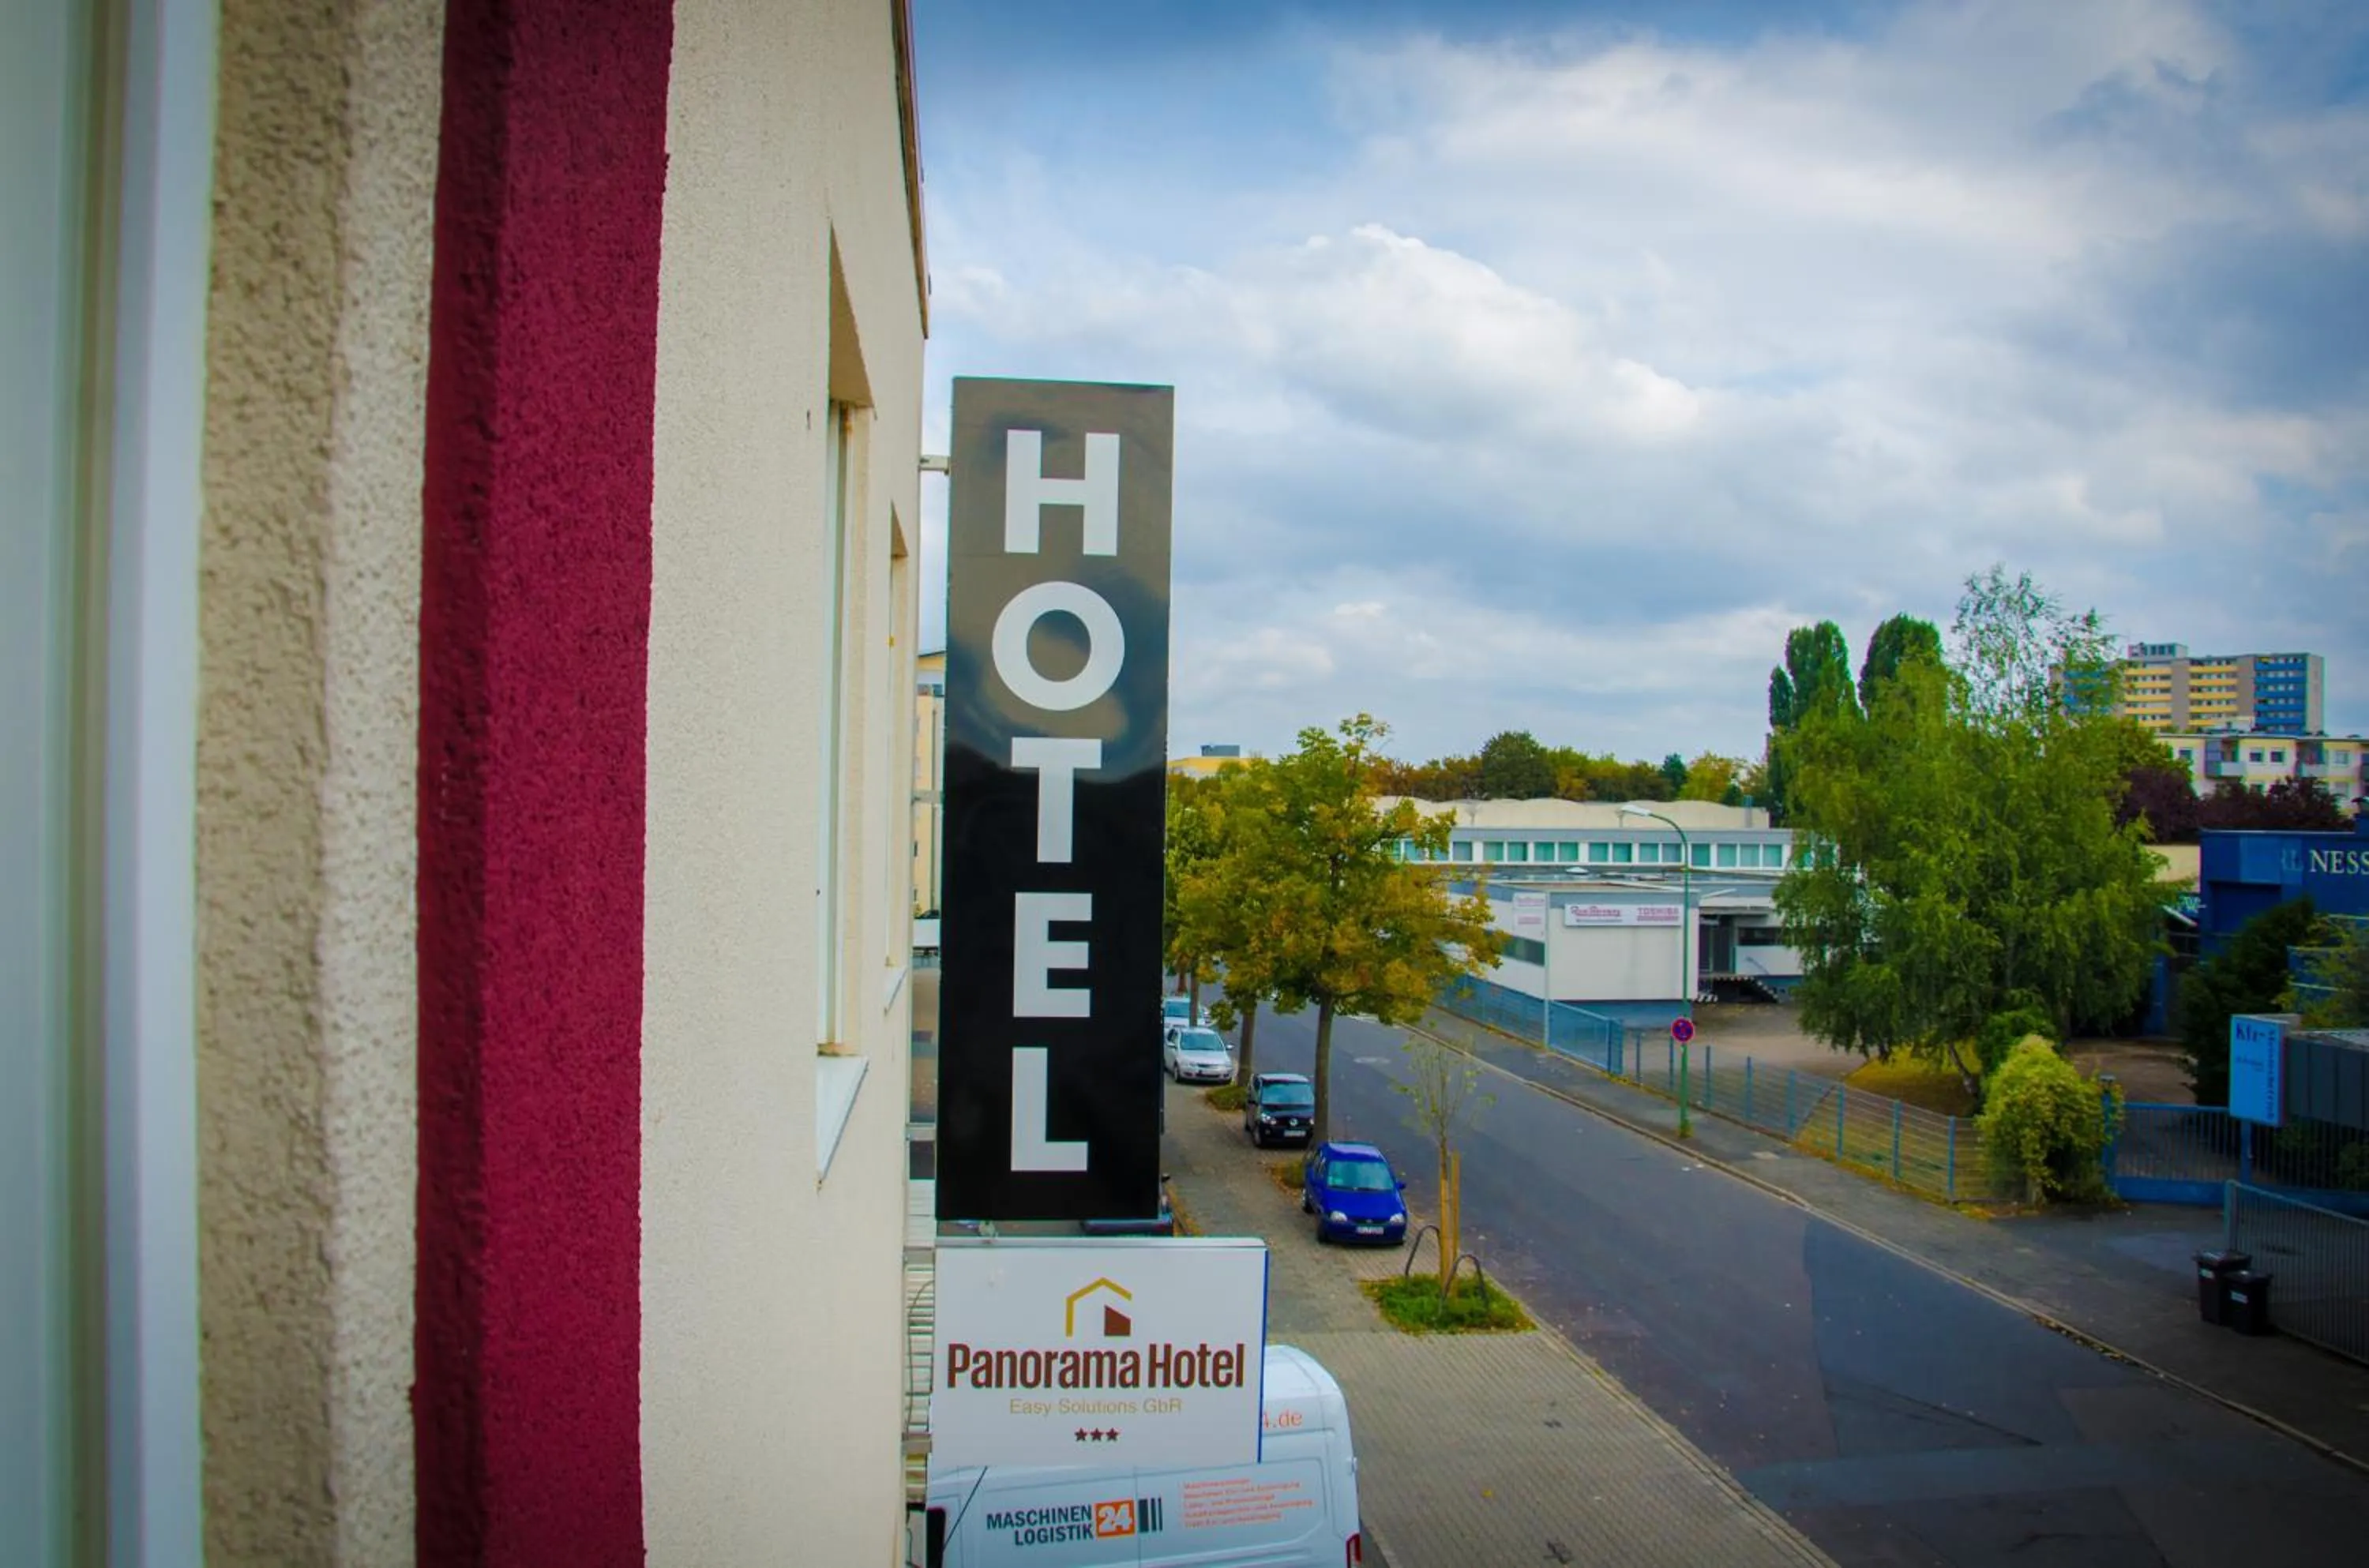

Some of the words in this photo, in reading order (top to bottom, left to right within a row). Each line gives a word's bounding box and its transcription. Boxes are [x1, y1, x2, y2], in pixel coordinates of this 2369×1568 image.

[991, 429, 1125, 1172] HOTEL
[947, 1343, 1141, 1389] Panorama
[1147, 1343, 1245, 1388] Hotel
[1008, 1398, 1052, 1418] Easy
[1058, 1397, 1138, 1415] Solutions
[1142, 1397, 1182, 1415] GbR
[987, 1504, 1092, 1530] MASCHINEN
[1014, 1515, 1094, 1547] LOGISTIK
[1098, 1503, 1132, 1533] 24
